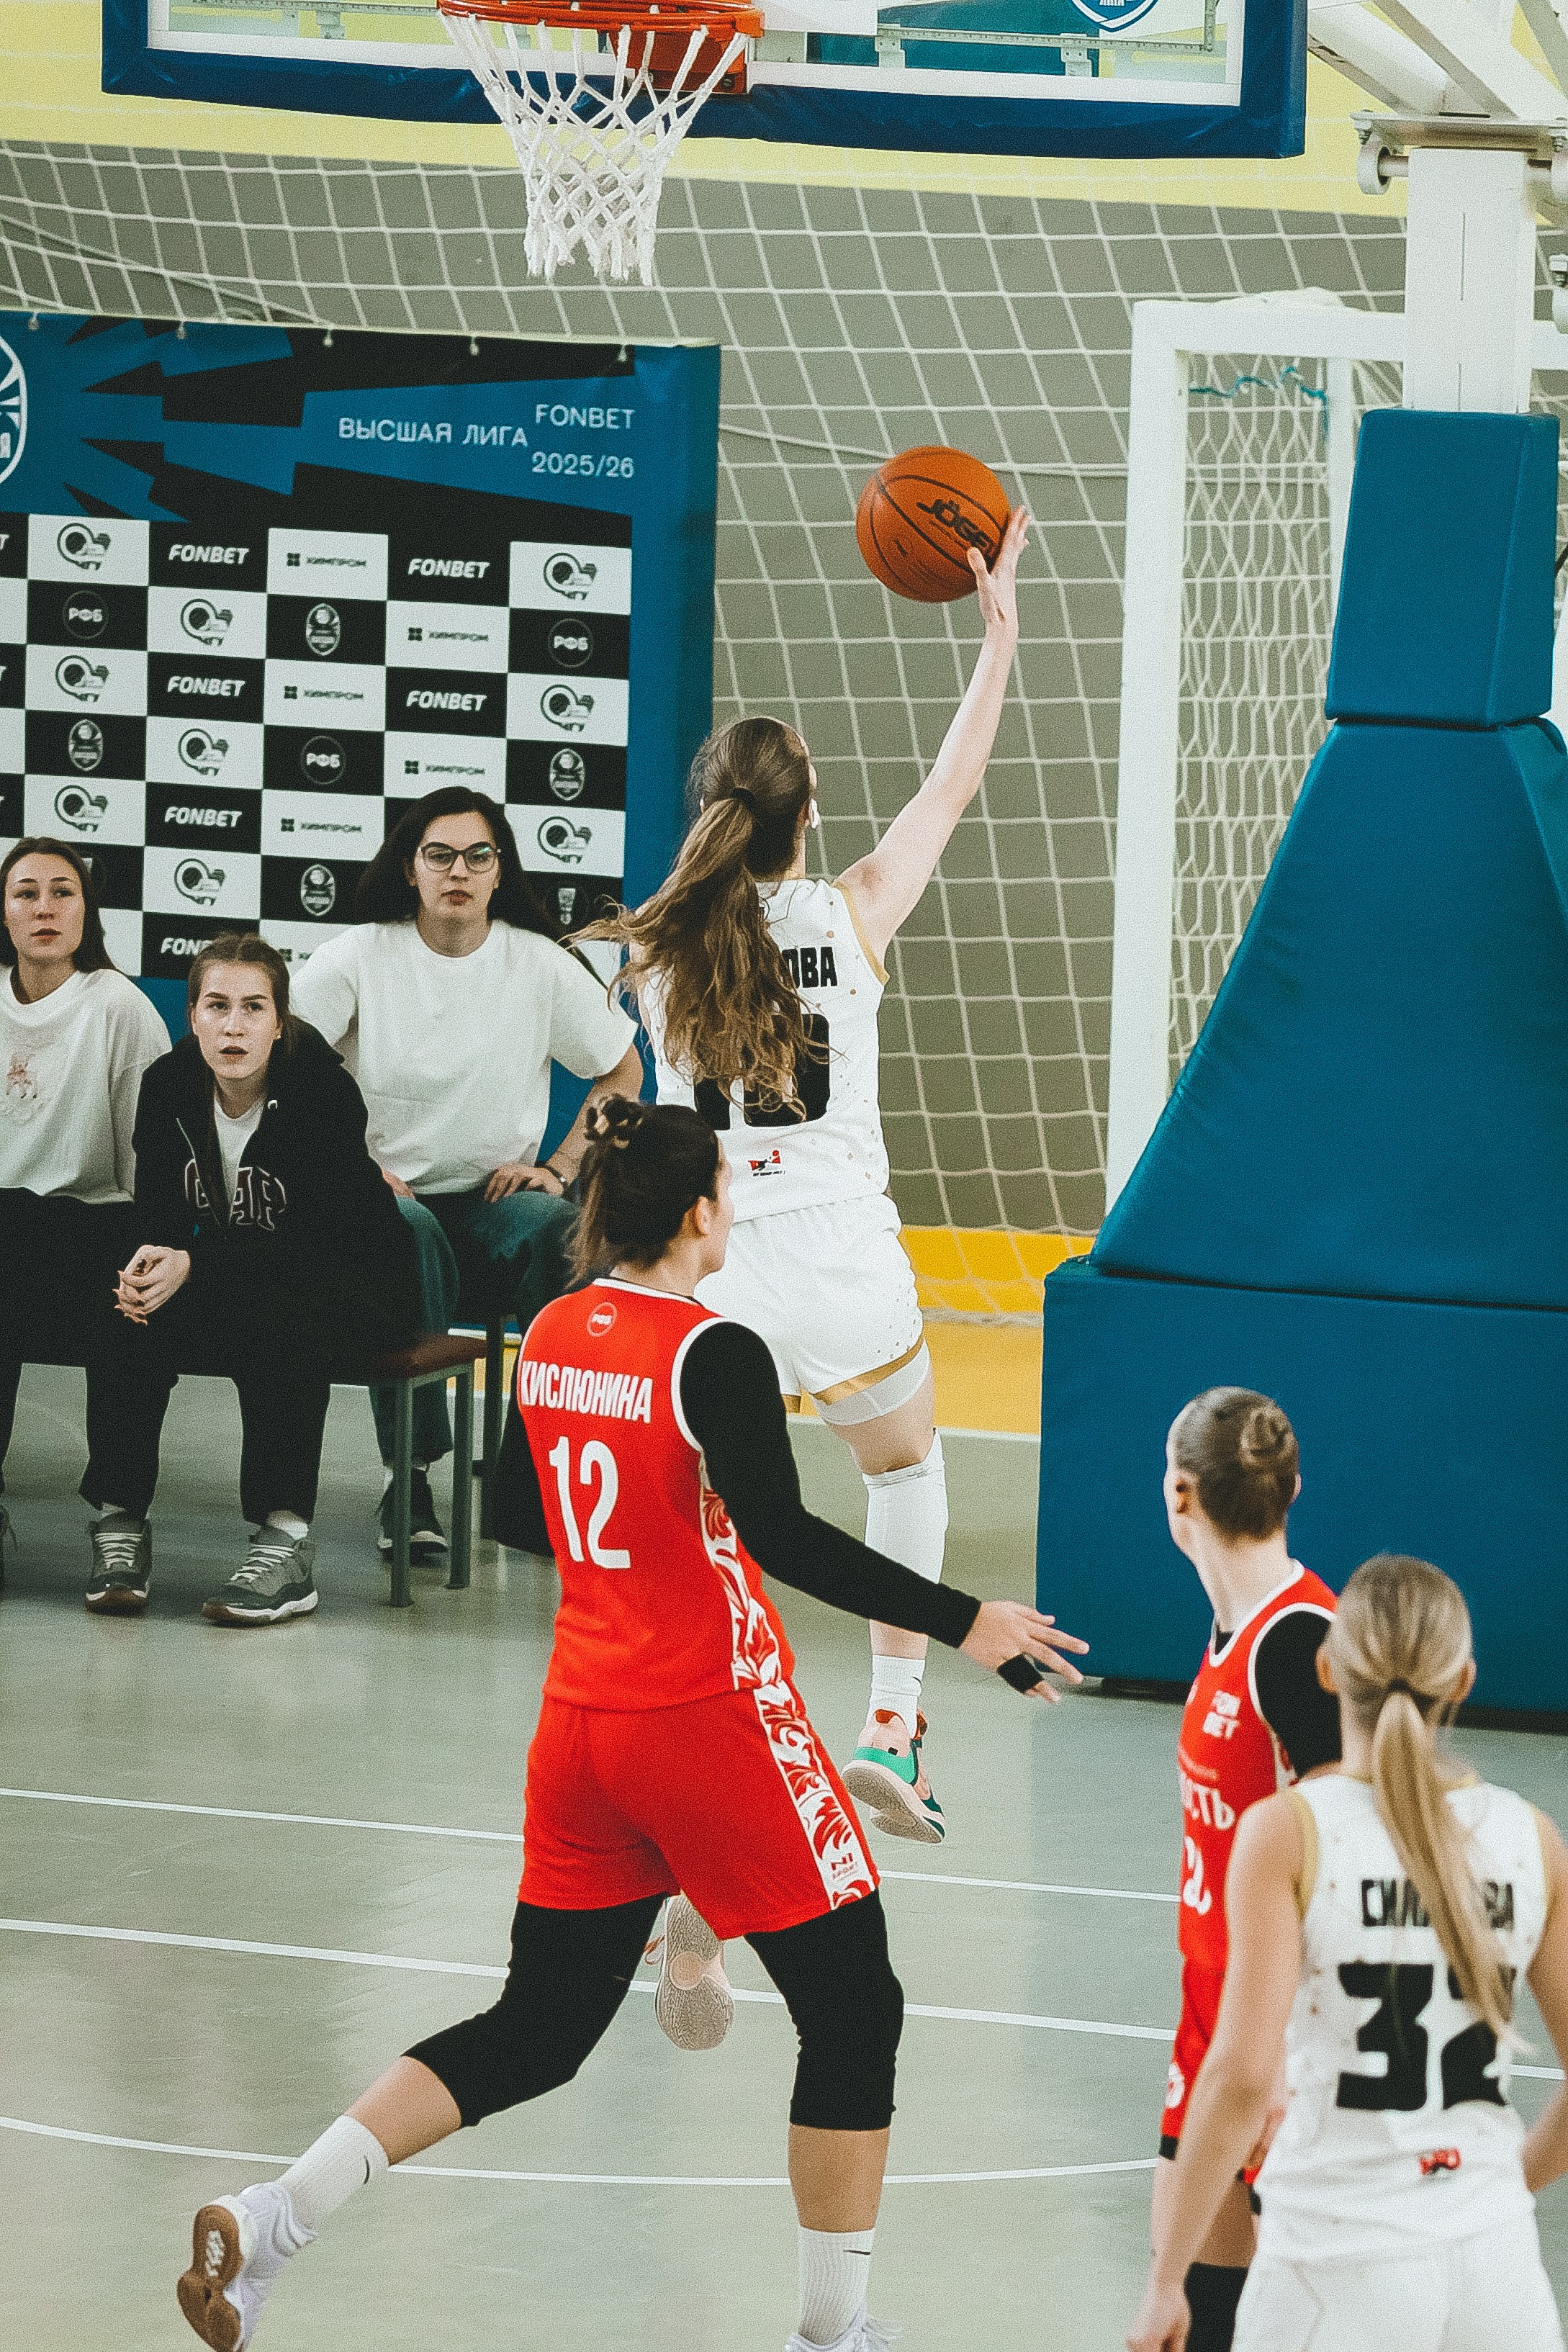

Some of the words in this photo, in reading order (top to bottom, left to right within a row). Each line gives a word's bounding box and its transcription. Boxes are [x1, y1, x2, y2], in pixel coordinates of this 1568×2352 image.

[536, 403, 635, 430] FONBET
[338, 417, 453, 443] ВЫСШАЯ
[462, 424, 528, 447] ЛИГА
[531, 451, 635, 479] 2025/26
[168, 544, 250, 565] FONBET
[407, 557, 490, 579] FONBET
[166, 675, 246, 698] FONBET
[405, 690, 488, 712] FONBET
[163, 806, 243, 828] FONBET
[781, 946, 839, 988] ОВА
[521, 1359, 654, 1425] КИСЛЮНИНА
[548, 1435, 631, 1570] 12
